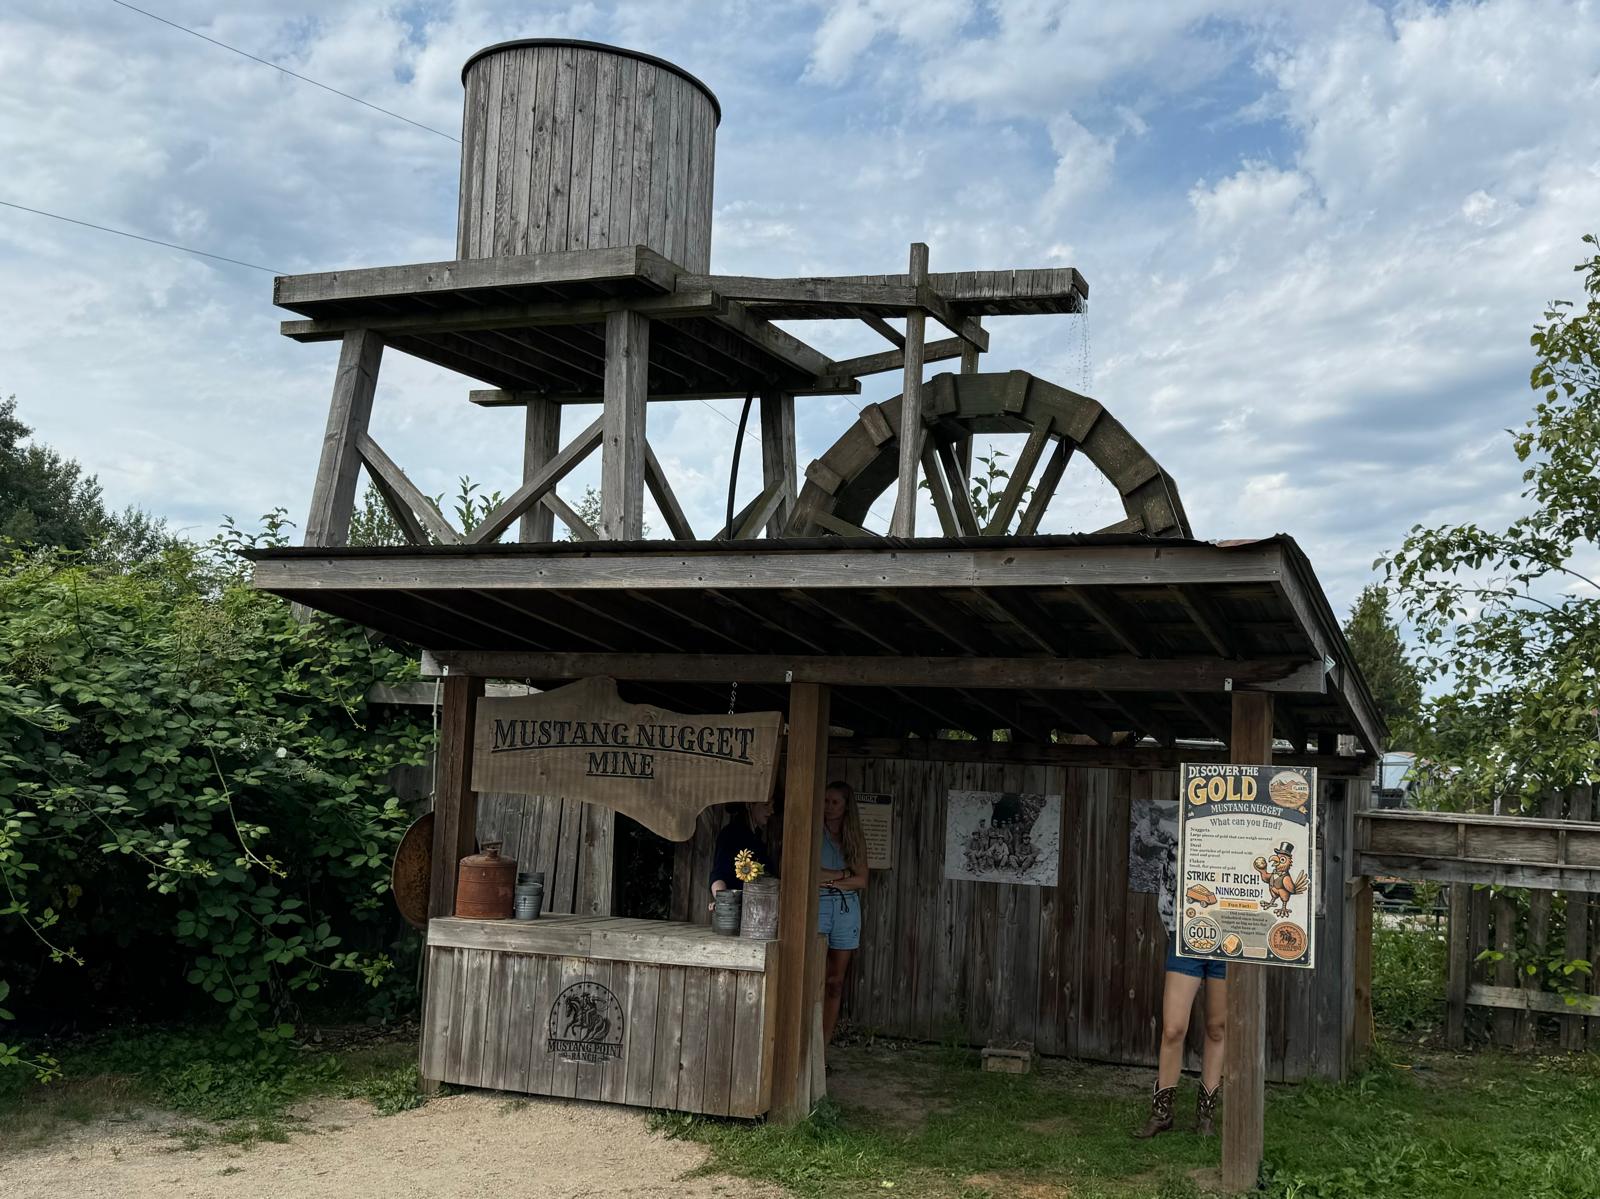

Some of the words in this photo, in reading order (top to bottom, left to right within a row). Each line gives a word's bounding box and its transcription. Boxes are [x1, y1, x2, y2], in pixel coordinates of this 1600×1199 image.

[492, 719, 628, 749] MUSTANG
[636, 724, 755, 760] NUGGET
[586, 752, 655, 776] MINE
[1188, 766, 1240, 778] DISCOVER
[1241, 766, 1259, 776] THE
[1187, 776, 1257, 805] GOLD
[1211, 803, 1249, 814] MUSTANG
[1251, 803, 1283, 816] NUGGET
[1210, 818, 1230, 827] What
[1231, 818, 1245, 826] can
[1246, 819, 1260, 827] you
[1262, 818, 1283, 830] find?
[1187, 871, 1215, 882] STRIKE
[1221, 873, 1230, 882] IT
[1233, 874, 1260, 885] RICH!
[1215, 886, 1263, 898] NINKOBIRD!
[1189, 926, 1217, 939] GOLD
[547, 1040, 592, 1053] MUSTANG
[595, 1043, 624, 1059] POINT
[571, 1052, 597, 1062] RANCH
